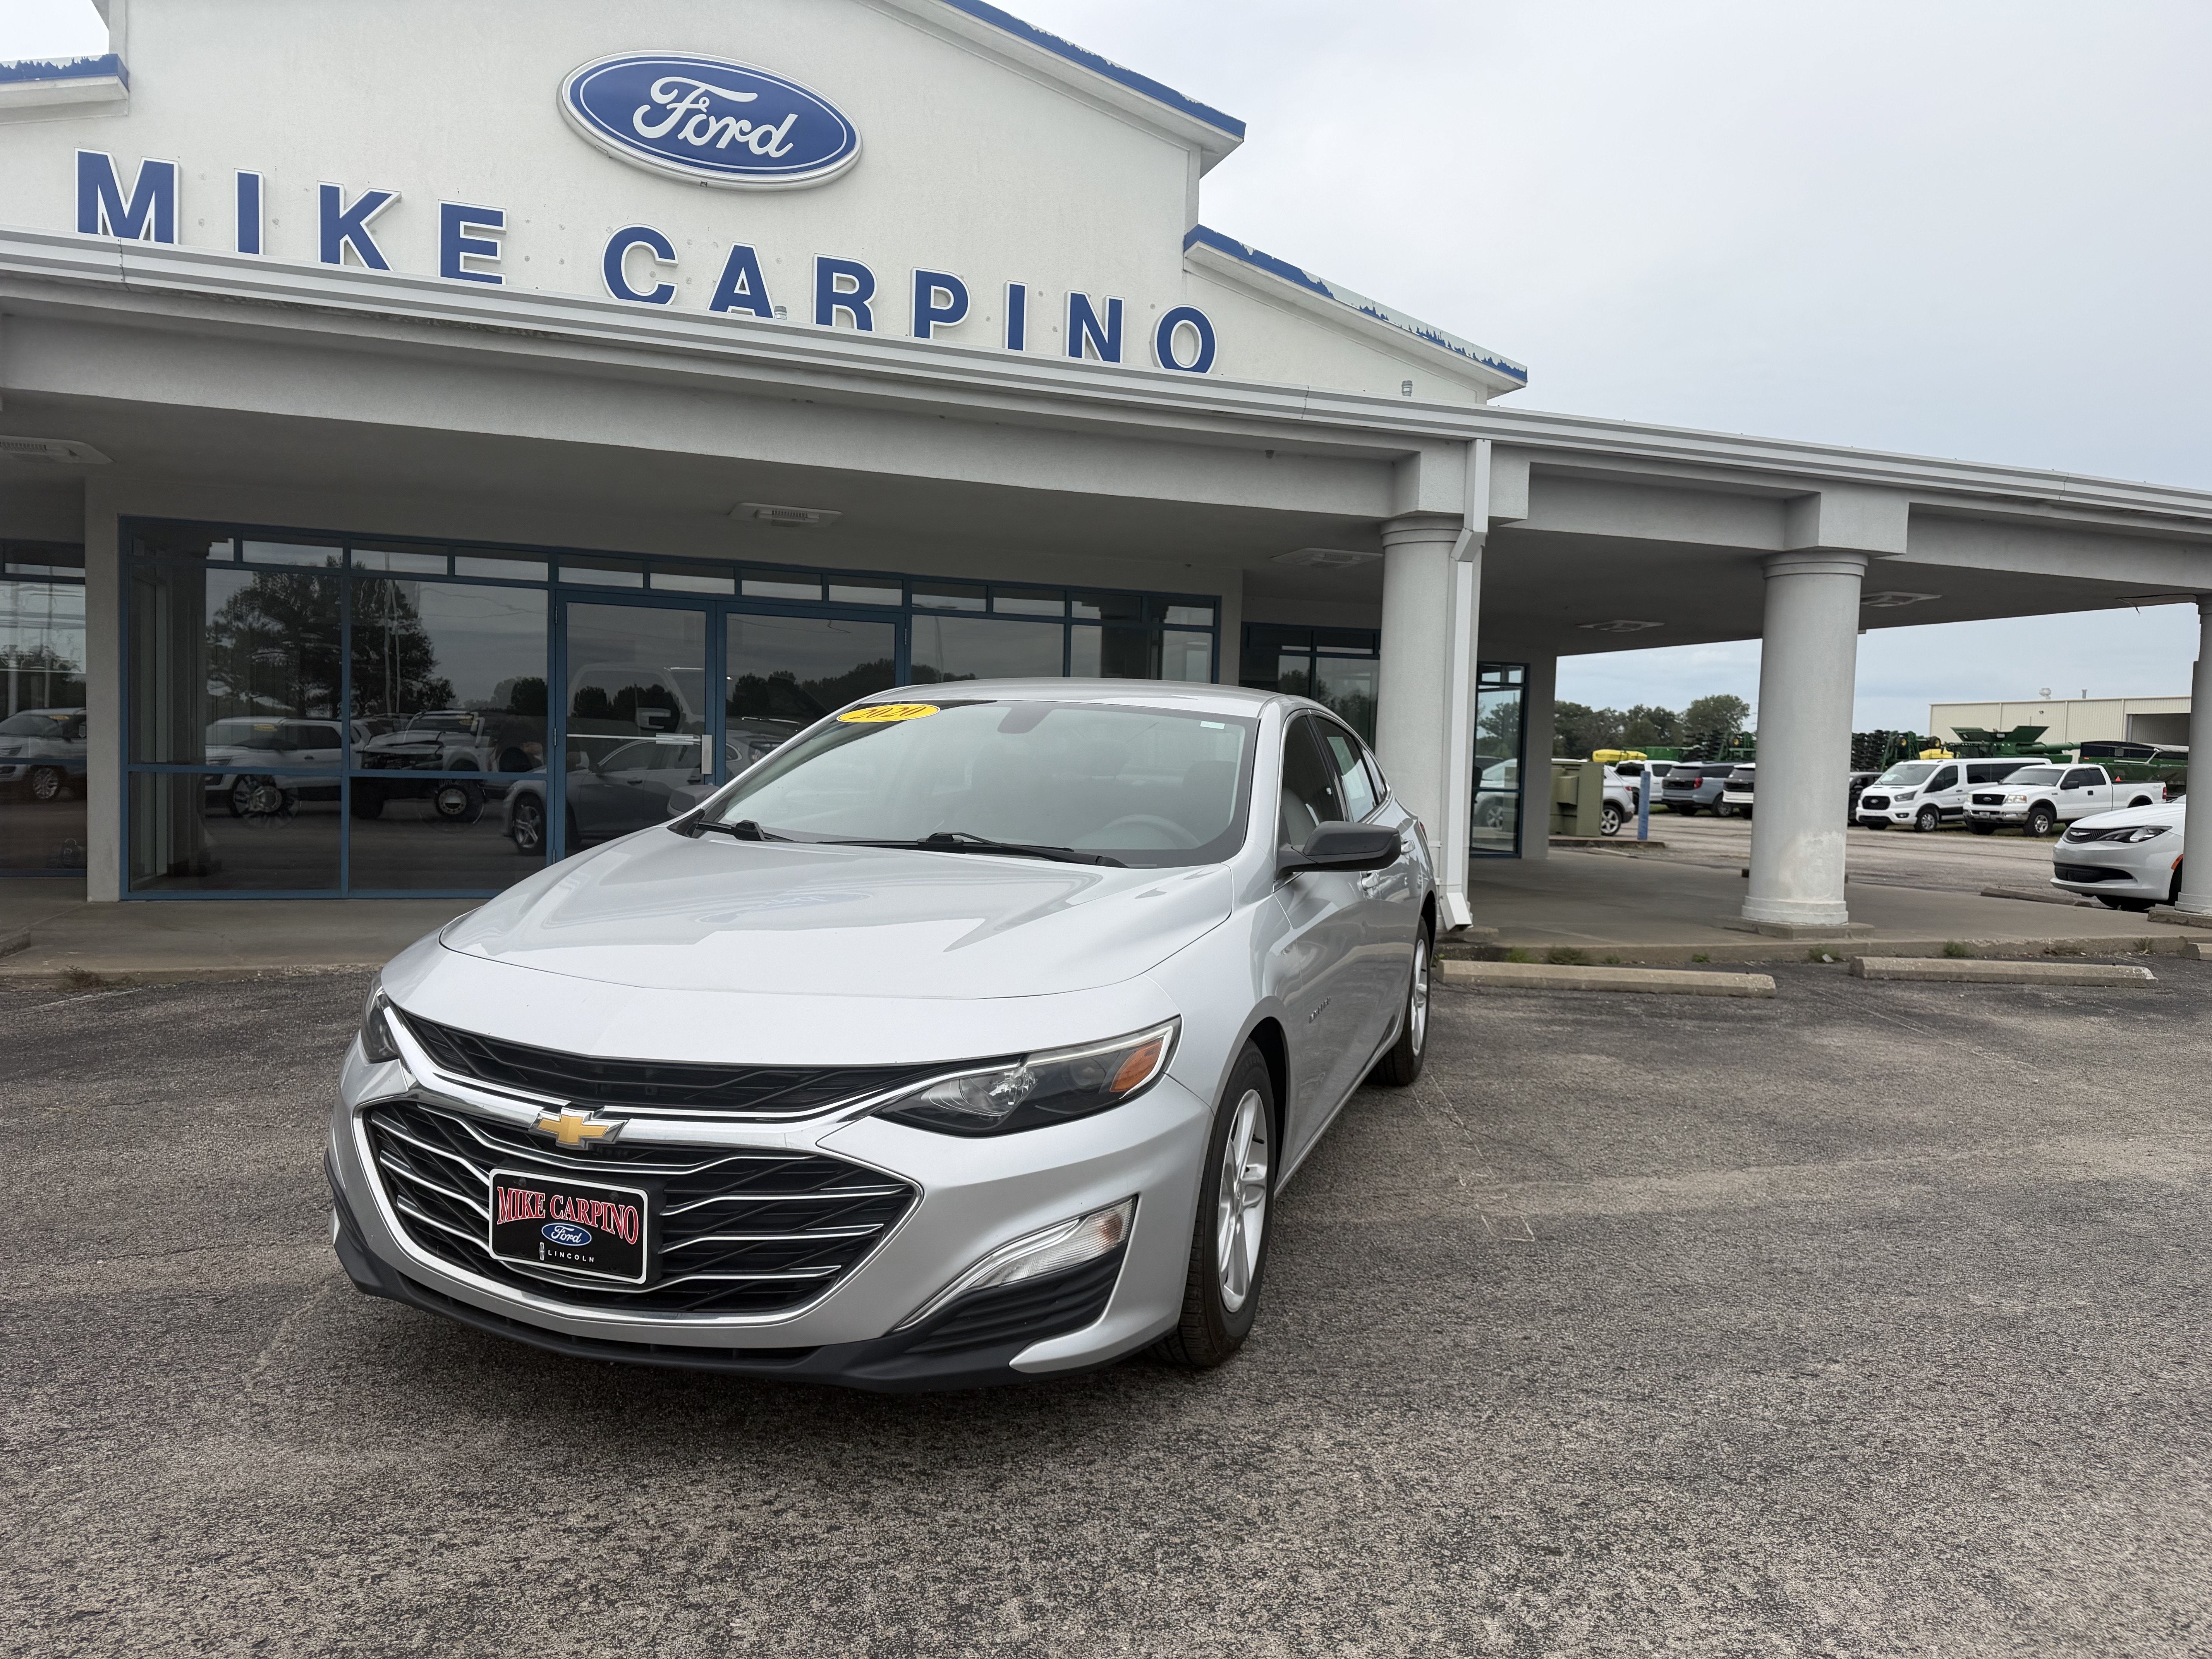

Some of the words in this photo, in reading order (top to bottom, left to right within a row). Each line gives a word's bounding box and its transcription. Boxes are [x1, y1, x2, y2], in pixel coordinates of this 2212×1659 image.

[633, 76, 798, 158] Ford
[74, 147, 507, 285] MIKE
[601, 223, 1218, 374] CARPINO
[848, 706, 927, 720] 2020
[497, 1186, 546, 1225] MIKE
[550, 1195, 639, 1245] CARPINO
[551, 1225, 582, 1243] Ford
[548, 1250, 594, 1263] LINCOLN
